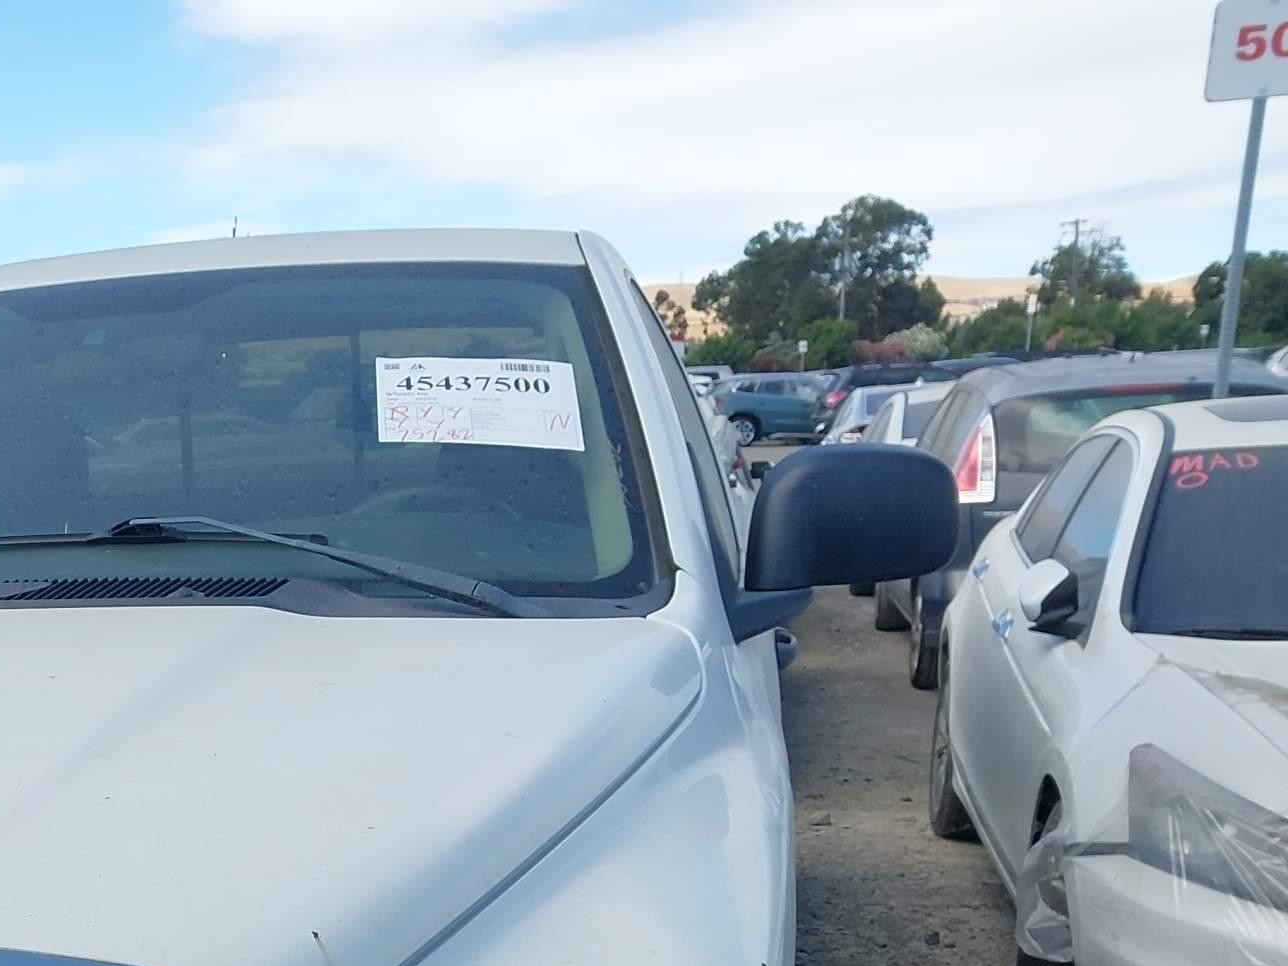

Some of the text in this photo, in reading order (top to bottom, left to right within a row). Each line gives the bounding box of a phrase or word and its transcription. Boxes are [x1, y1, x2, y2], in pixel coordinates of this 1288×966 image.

[396, 375, 551, 395] 45437500
[550, 412, 571, 431] N
[1169, 452, 1260, 475] MAD
